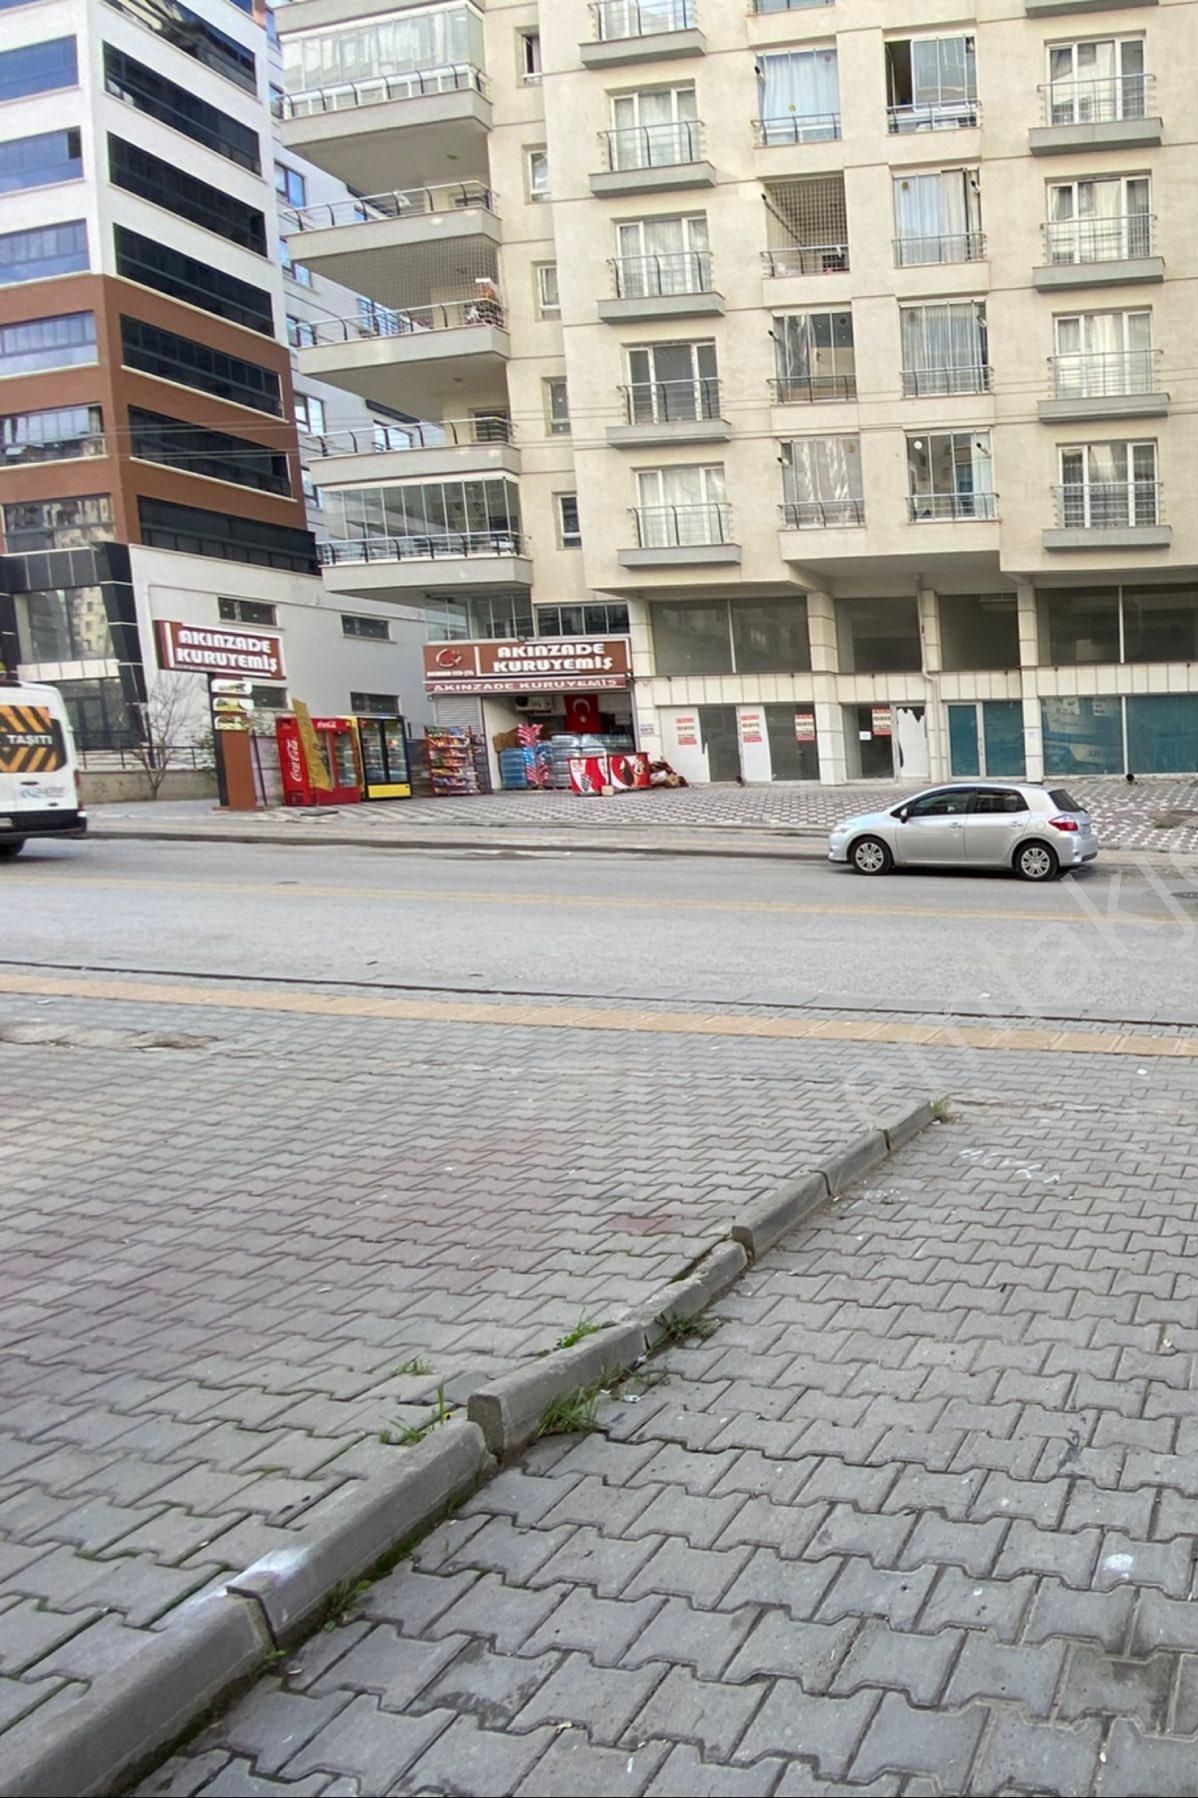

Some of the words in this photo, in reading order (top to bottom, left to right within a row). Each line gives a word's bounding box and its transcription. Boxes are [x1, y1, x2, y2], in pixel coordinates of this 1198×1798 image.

[178, 630, 272, 653] AKINZADE
[497, 643, 605, 658] AKINZADE
[175, 647, 278, 672] KURUYEMİŞ
[493, 656, 614, 673] KURUYEMİŞ
[433, 682, 514, 691] AKINZADE
